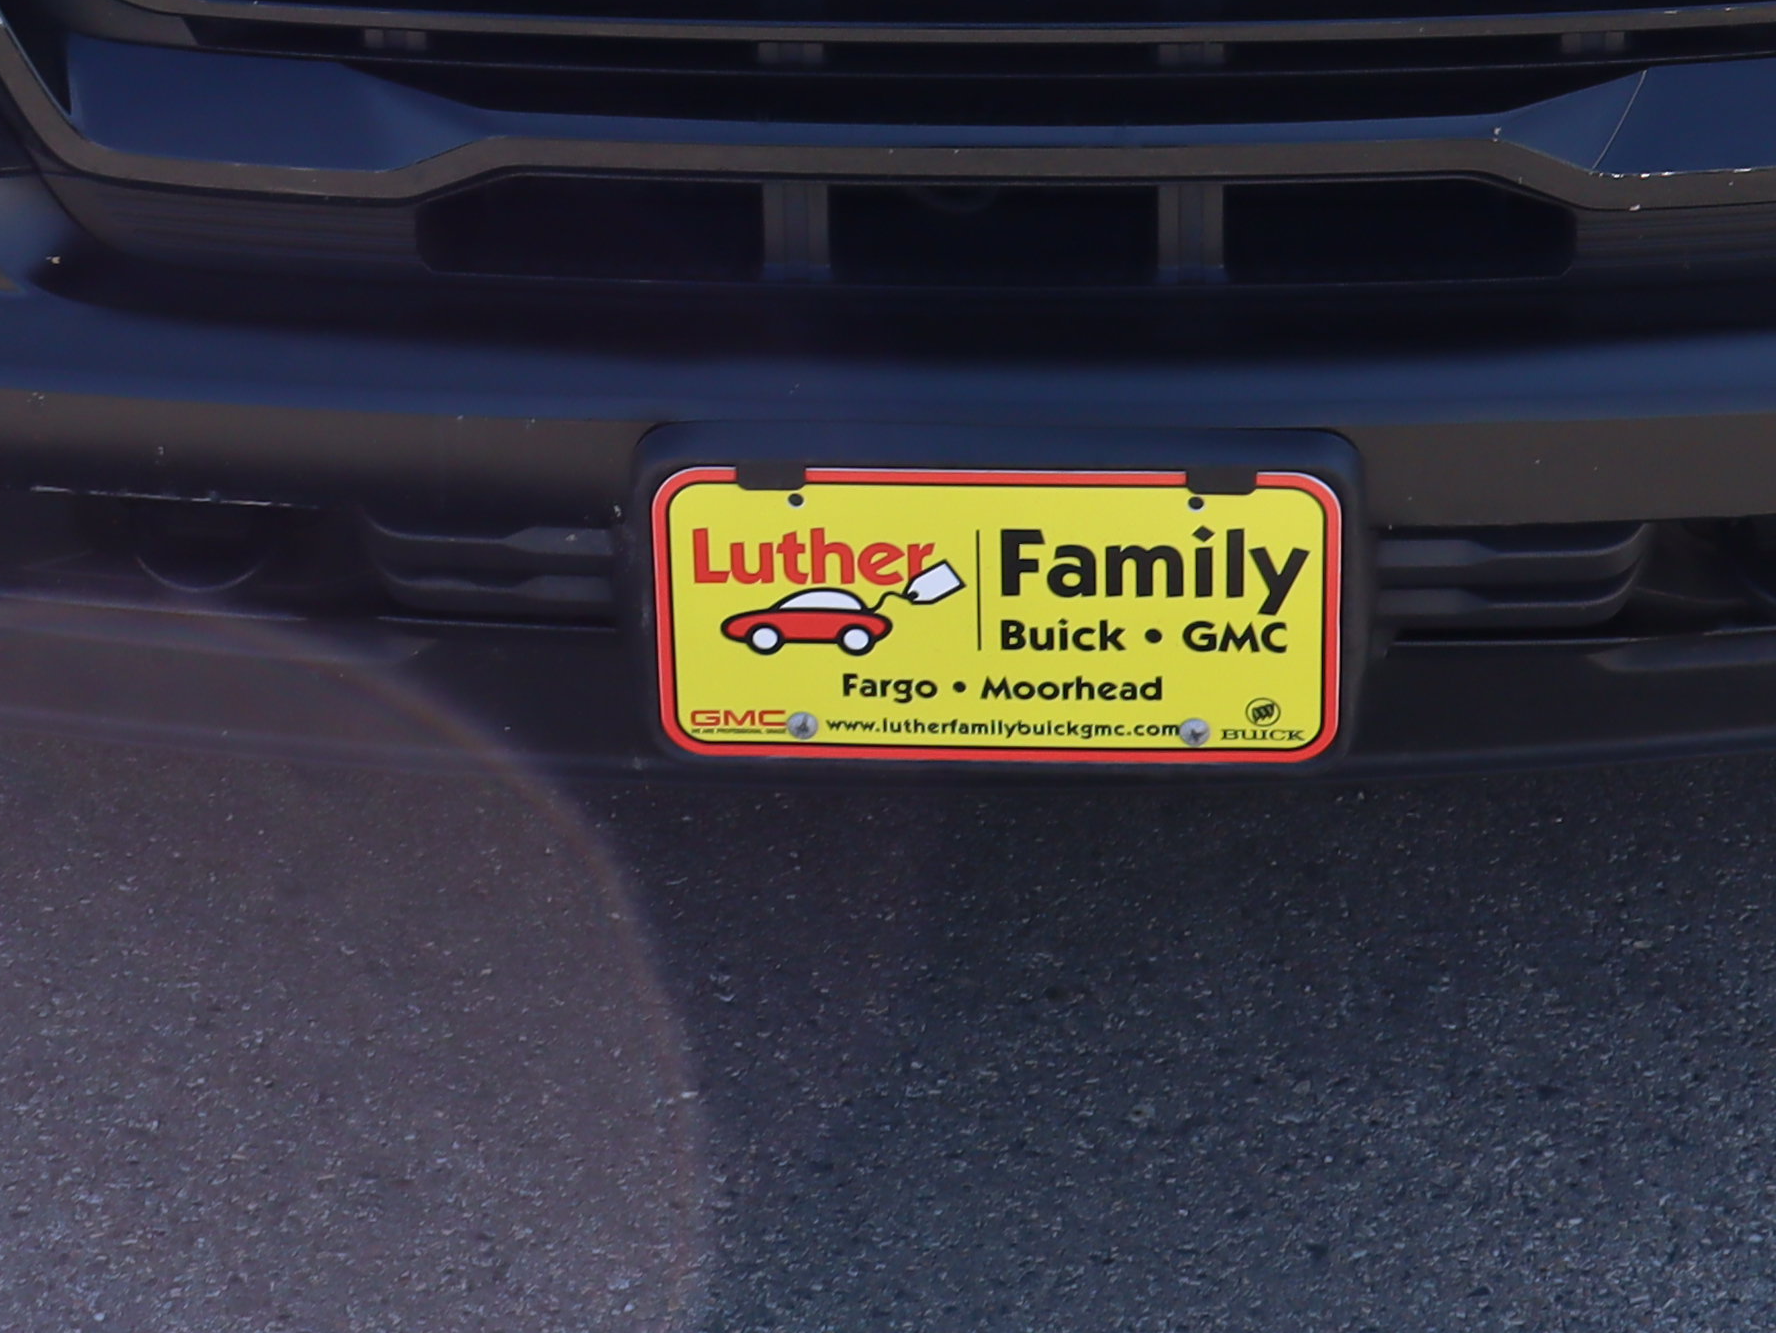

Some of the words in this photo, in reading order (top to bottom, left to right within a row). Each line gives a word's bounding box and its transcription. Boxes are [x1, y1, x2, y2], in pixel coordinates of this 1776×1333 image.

[691, 527, 936, 586] Luther
[999, 525, 1311, 616] Family
[1000, 618, 1127, 652] Buick
[1182, 620, 1289, 654] GMC
[841, 672, 939, 704] Fargo
[980, 675, 1164, 701] Moorhead
[689, 709, 787, 727] GMC
[826, 717, 1181, 740] www.lutherfamilybuickgmc.com
[1219, 728, 1306, 742] BUICK
